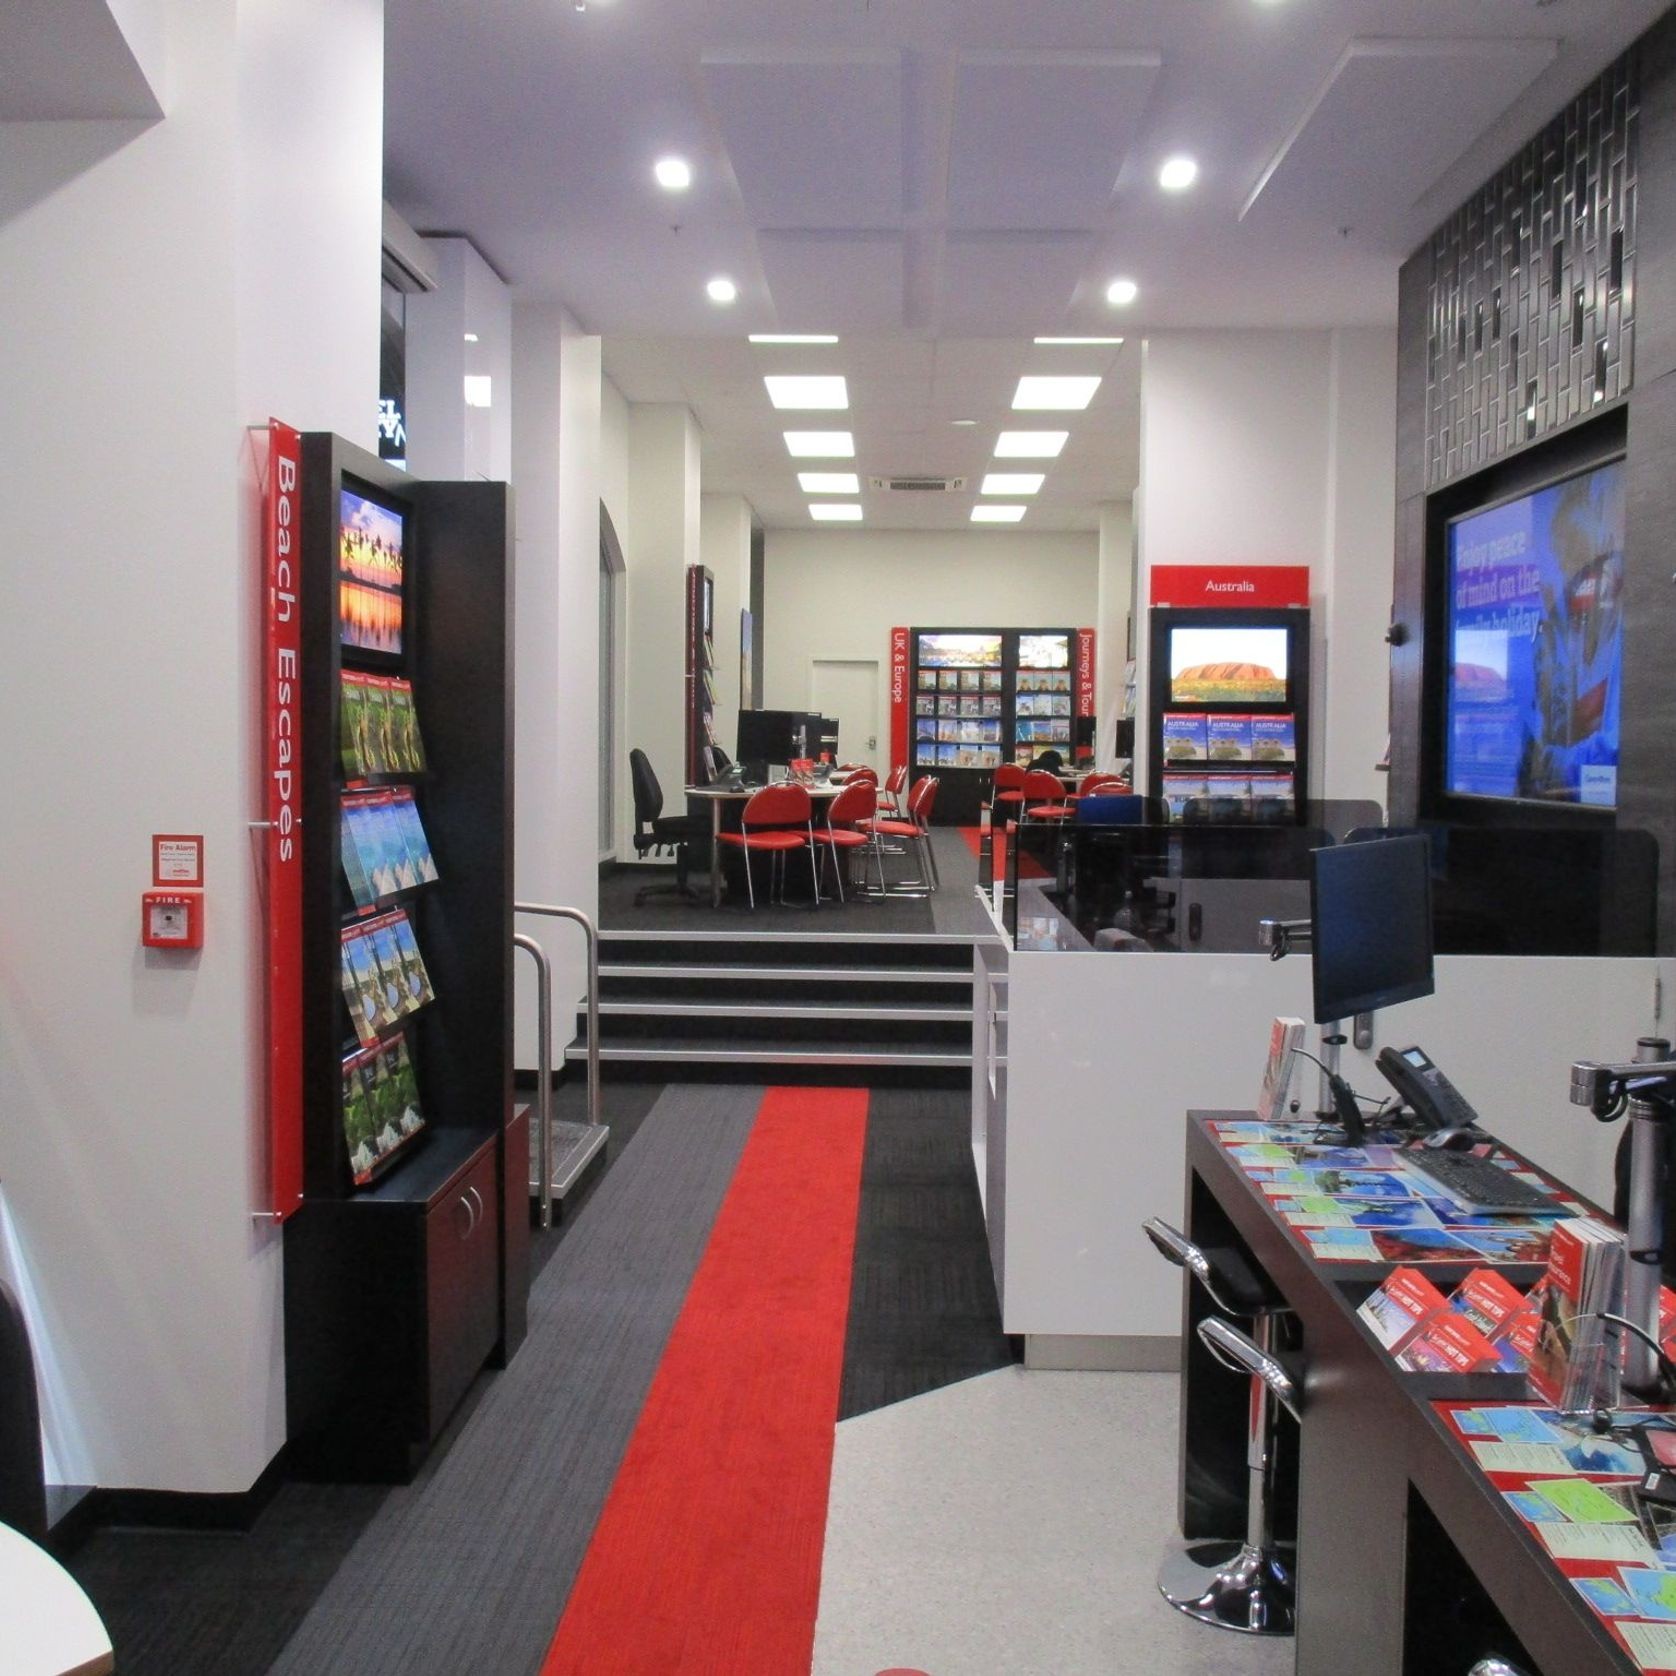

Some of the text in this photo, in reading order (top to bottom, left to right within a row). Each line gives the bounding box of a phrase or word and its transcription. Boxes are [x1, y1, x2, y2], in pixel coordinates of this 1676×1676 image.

[1205, 580, 1255, 592] Australia
[1456, 566, 1540, 610] of mind on the
[274, 455, 296, 862] Beach Escapes
[891, 632, 905, 703] UK & Europe
[1079, 633, 1093, 679] Journeys
[1081, 682, 1092, 691] &
[155, 896, 181, 904] FIRE
